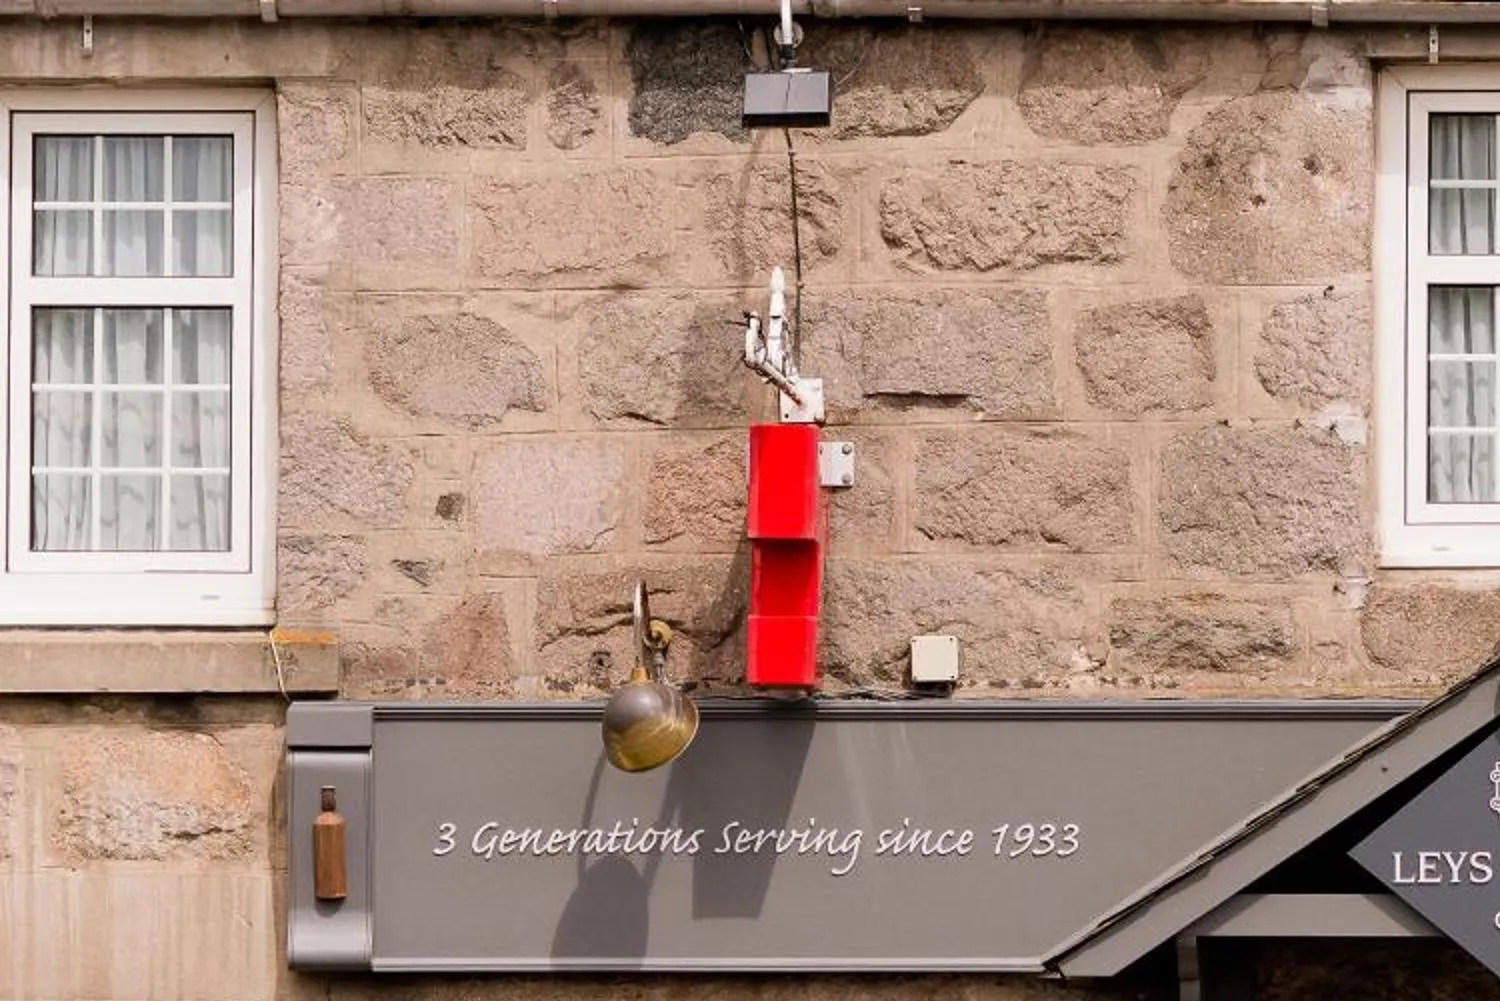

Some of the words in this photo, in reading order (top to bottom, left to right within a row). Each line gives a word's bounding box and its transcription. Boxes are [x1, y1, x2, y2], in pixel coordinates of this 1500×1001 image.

[433, 822, 457, 856] 3
[471, 818, 705, 859] Generations
[714, 818, 863, 875] Serving
[875, 818, 974, 856] since
[992, 823, 1081, 857] 1933
[1392, 851, 1493, 883] LEYS
